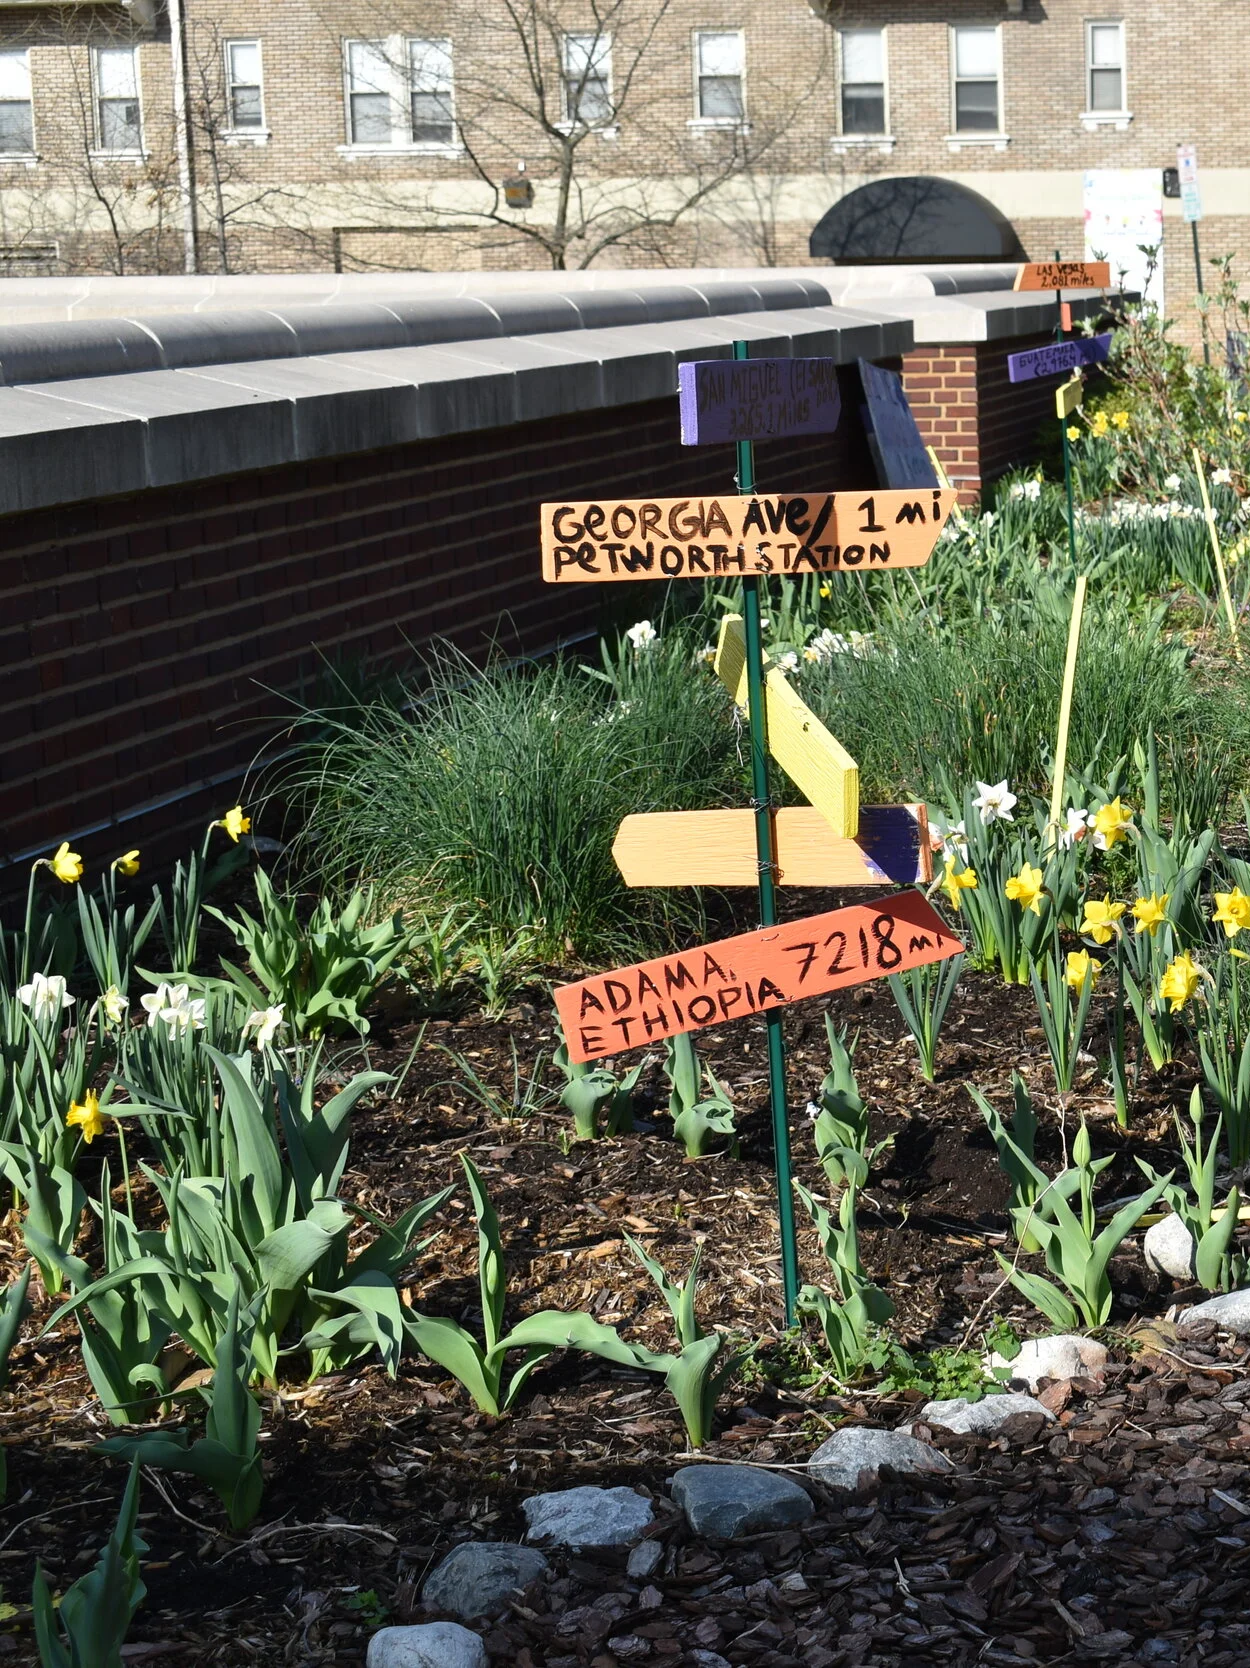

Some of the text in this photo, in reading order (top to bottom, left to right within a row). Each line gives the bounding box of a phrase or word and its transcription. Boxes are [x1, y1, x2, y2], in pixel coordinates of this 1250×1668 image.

[1036, 264, 1053, 276] LAS
[699, 367, 726, 414] SAN
[730, 362, 783, 404] MIGUEL
[858, 496, 886, 532] 1
[754, 540, 891, 574] STATION
[782, 914, 902, 984] 7218
[580, 976, 787, 1054] ETHIOPIA
